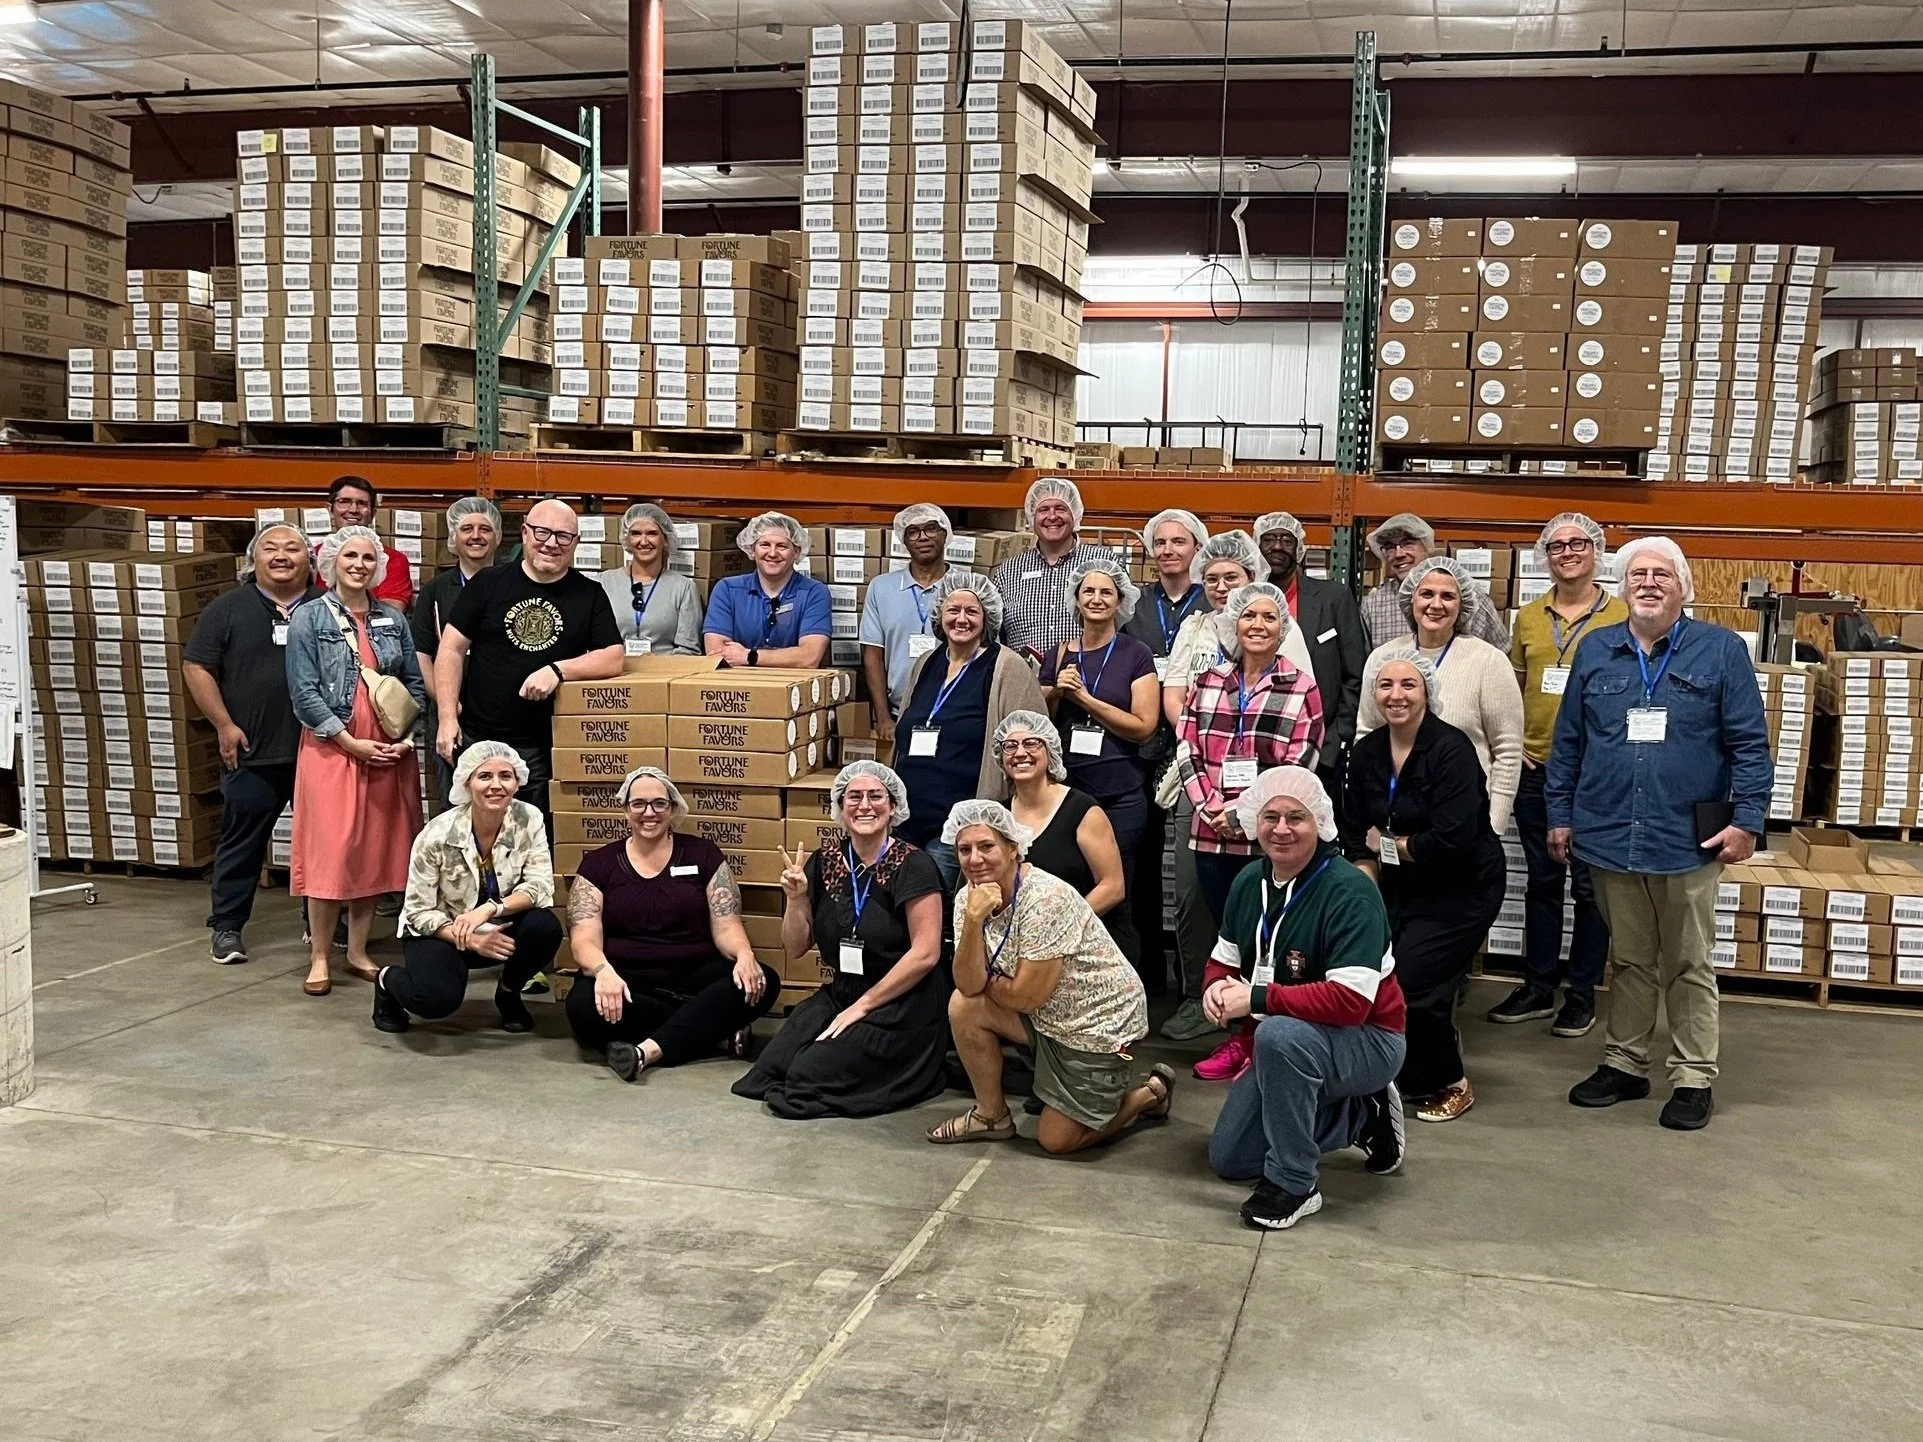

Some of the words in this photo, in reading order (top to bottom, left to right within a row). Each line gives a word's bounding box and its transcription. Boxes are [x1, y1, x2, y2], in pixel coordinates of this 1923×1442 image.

[609, 240, 648, 250] FORTUNE
[701, 240, 741, 250] FORTUNE
[612, 250, 645, 259] FAVORS
[705, 250, 737, 260] FAVORS
[503, 598, 542, 624] FORTUNE
[541, 600, 564, 632] FAVORS
[519, 635, 558, 652] ENCHANTED
[582, 688, 632, 699] FORTUNE
[701, 690, 751, 702] FORTUNE
[587, 699, 628, 709] FAVORS
[705, 702, 747, 713] FAVORS
[581, 721, 630, 732] FORTUNE
[698, 723, 749, 735] FORTUNE
[586, 732, 627, 742] FAVORS
[703, 735, 745, 747] FAVORS
[580, 754, 629, 765] FORTUNE
[698, 755, 749, 767] FORTUNE
[585, 765, 626, 775] FAVORS
[703, 767, 745, 778] FAVORS
[577, 786, 620, 797] FORTUN
[692, 789, 743, 800] FORTUNE
[697, 800, 738, 811] FAVORS
[697, 821, 747, 833] FORTUNE
[587, 829, 628, 839] FAVORS
